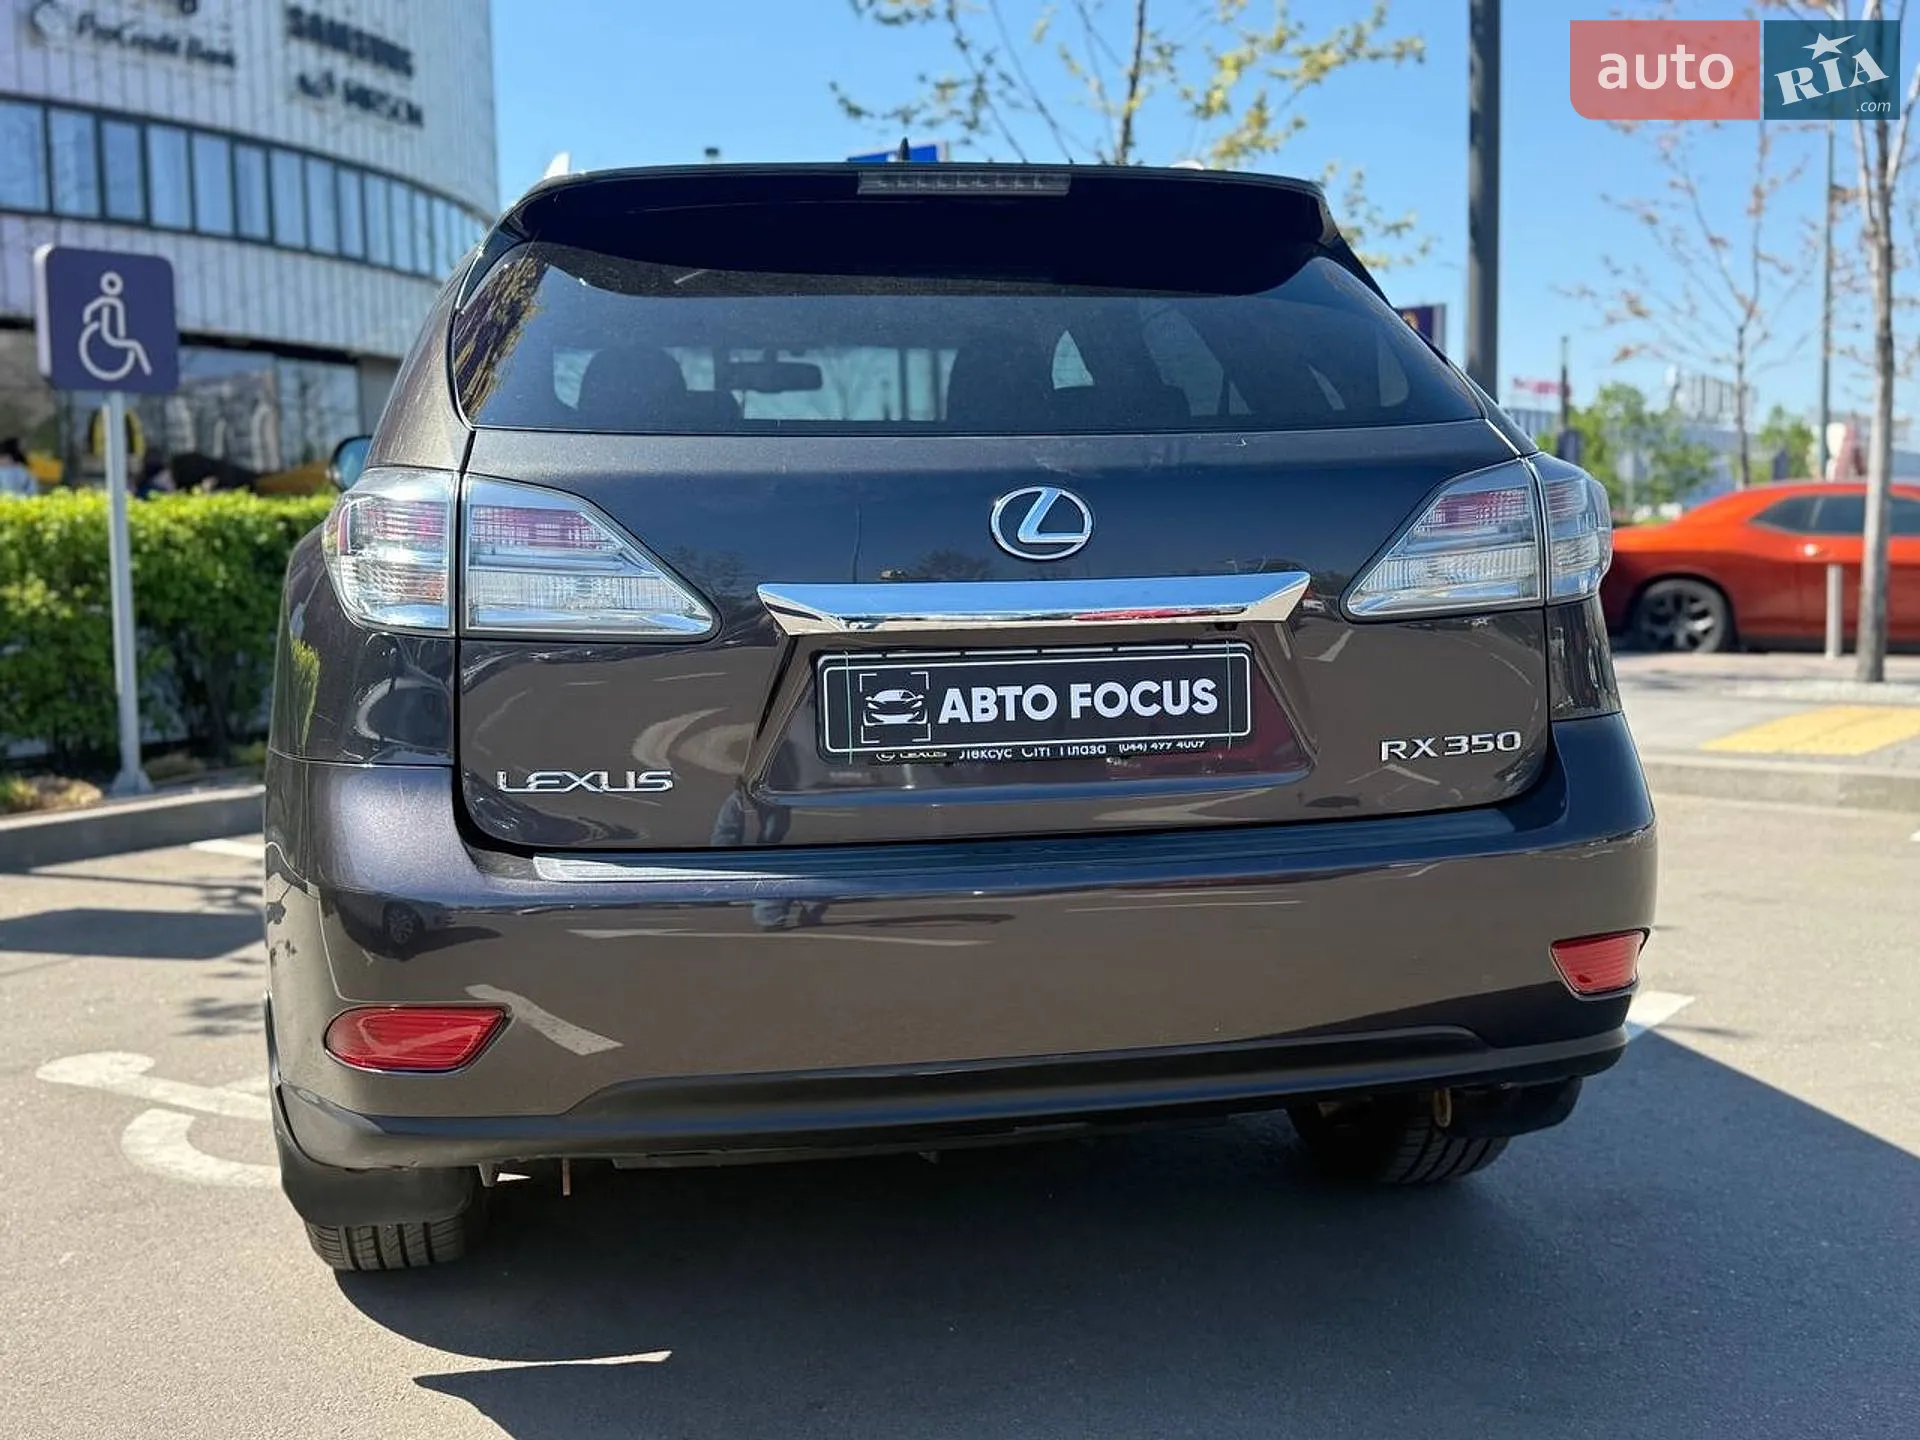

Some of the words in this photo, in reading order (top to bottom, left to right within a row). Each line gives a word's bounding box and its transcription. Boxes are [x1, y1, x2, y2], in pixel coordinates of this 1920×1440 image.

[938, 684, 1058, 724] АВТО
[1070, 679, 1217, 719] FOCUS
[1381, 737, 1439, 761] RX
[1444, 731, 1521, 756] 350
[497, 770, 674, 793] LEXUS
